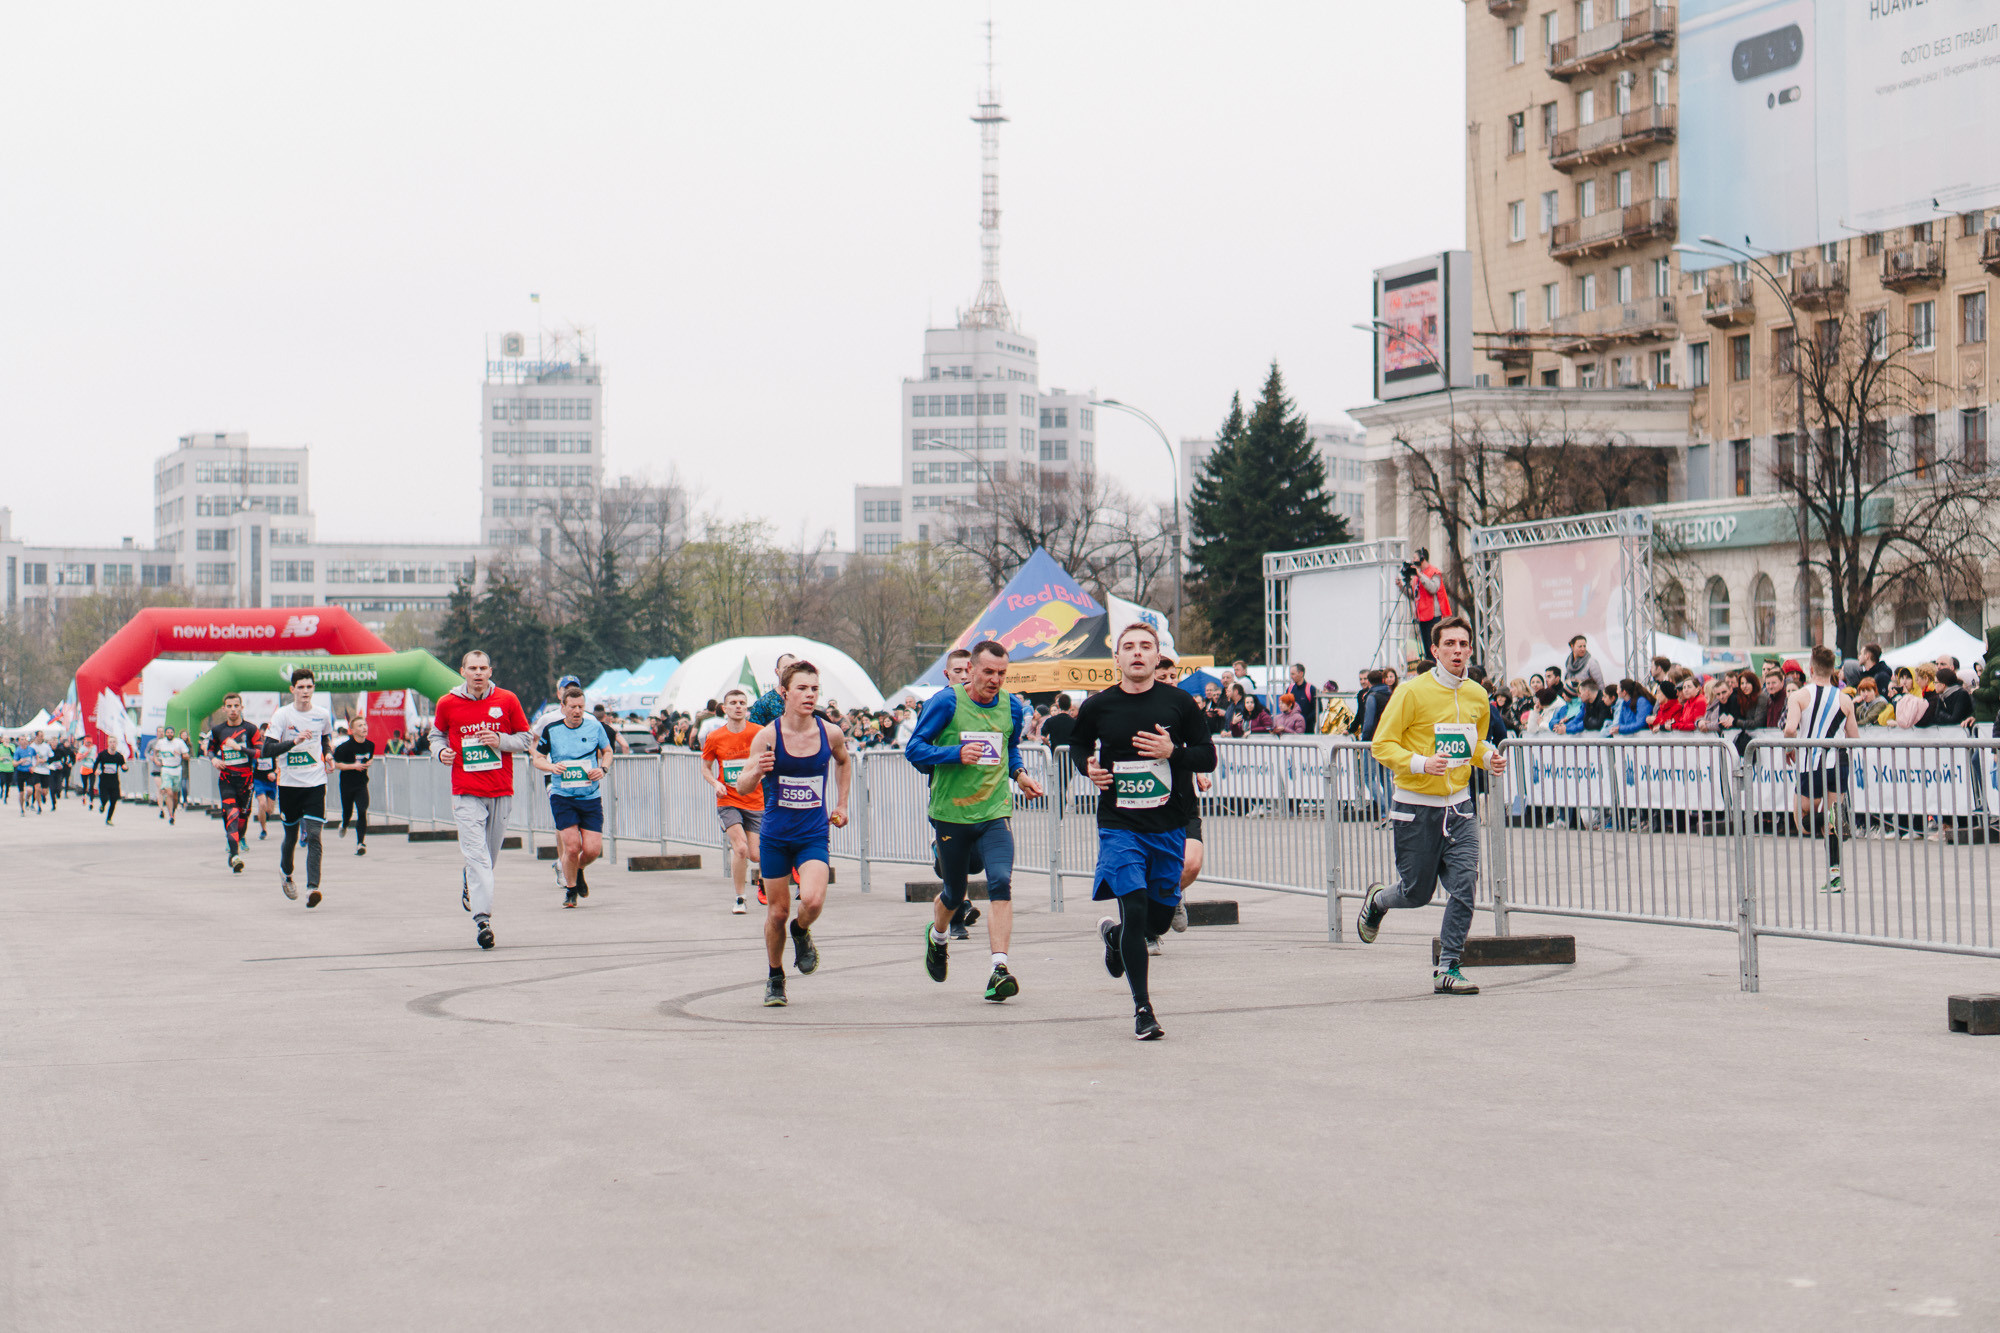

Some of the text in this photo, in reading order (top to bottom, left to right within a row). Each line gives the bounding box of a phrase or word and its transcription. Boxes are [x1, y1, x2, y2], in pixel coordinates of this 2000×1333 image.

[1900, 23, 1998, 65] ФОТО БЕЗ ПРАВИЛ
[1006, 583, 1095, 612] Red Bull
[173, 624, 208, 639] new
[209, 622, 276, 639] balance
[301, 662, 377, 672] HERBALIFE
[313, 669, 378, 682] UTRITION
[1436, 740, 1466, 754] 2603
[288, 755, 309, 764] 2134
[465, 750, 490, 761] 3214
[562, 770, 583, 779] 1095
[1873, 763, 1963, 788] Жилстрой-1
[1117, 779, 1156, 794] 2569
[782, 788, 813, 801] 5596
